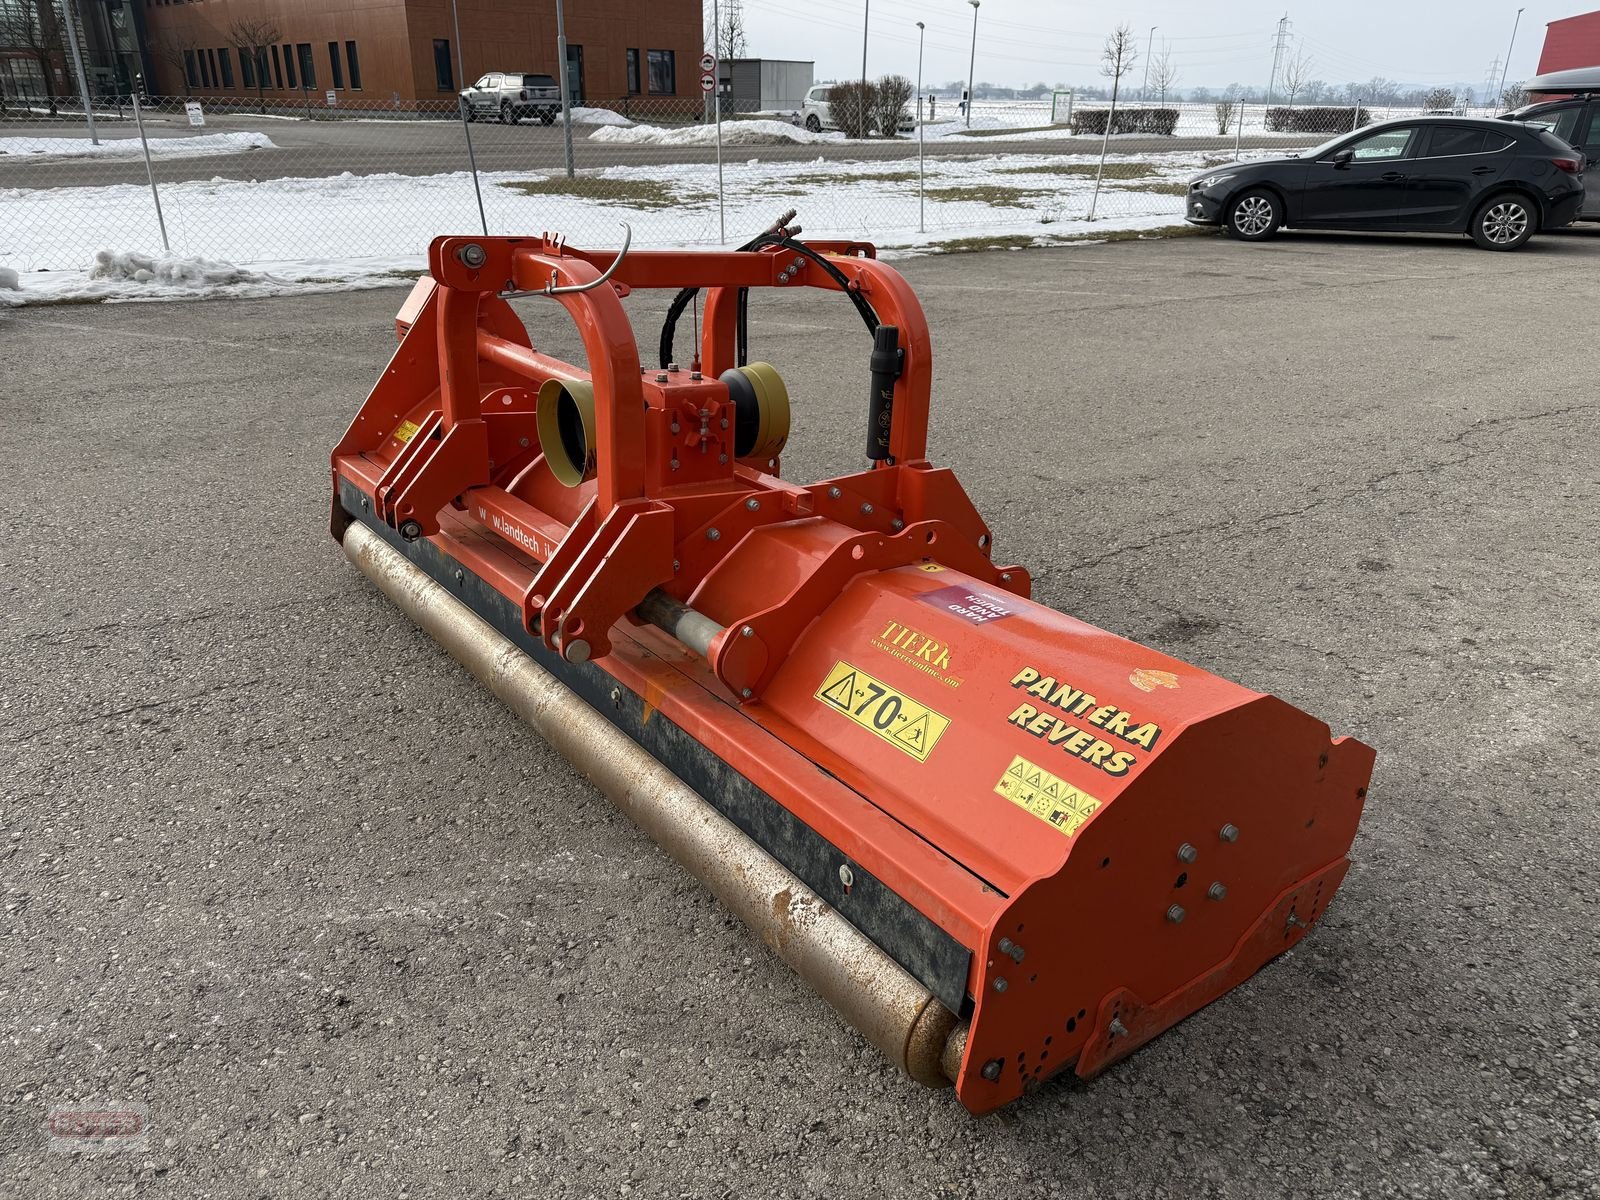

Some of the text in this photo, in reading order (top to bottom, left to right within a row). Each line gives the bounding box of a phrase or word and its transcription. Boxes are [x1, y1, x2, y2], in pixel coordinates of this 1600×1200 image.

[948, 603, 988, 622] HARD
[965, 594, 1011, 616] TOUGH
[968, 604, 1000, 618] AND
[853, 682, 903, 730] 70
[1008, 665, 1163, 752] PANTERA
[1006, 701, 1138, 777] REVERS
